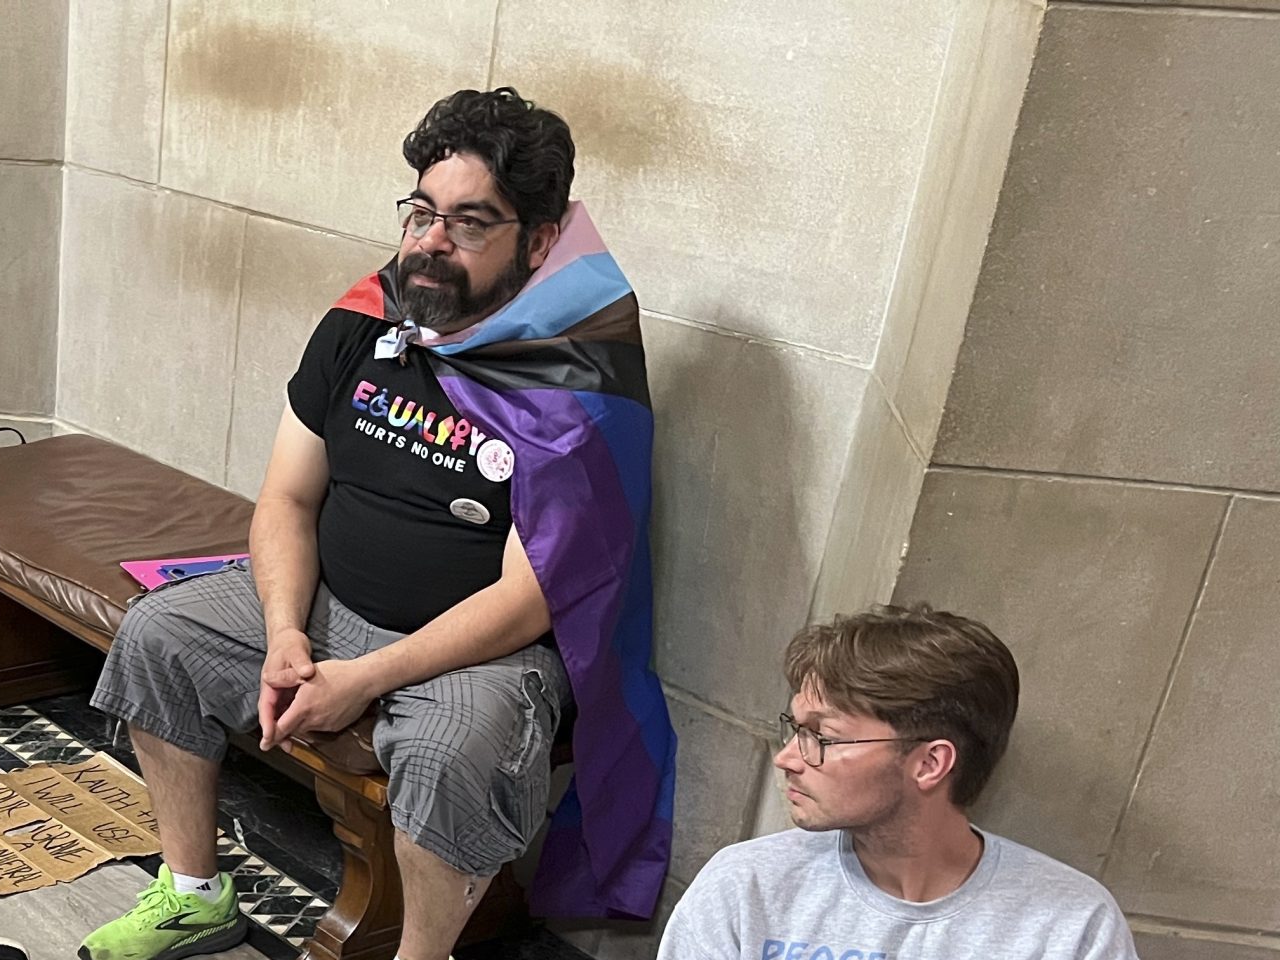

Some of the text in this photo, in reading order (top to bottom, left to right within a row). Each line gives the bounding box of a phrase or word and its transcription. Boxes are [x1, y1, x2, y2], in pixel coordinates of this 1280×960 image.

[354, 417, 407, 449] HURTS
[410, 440, 429, 460] NO
[431, 452, 467, 473] ONE
[24, 777, 56, 786] I
[61, 763, 140, 811] KAUTH
[34, 781, 83, 815] WILL
[92, 821, 145, 844] USE
[10, 842, 35, 852] A
